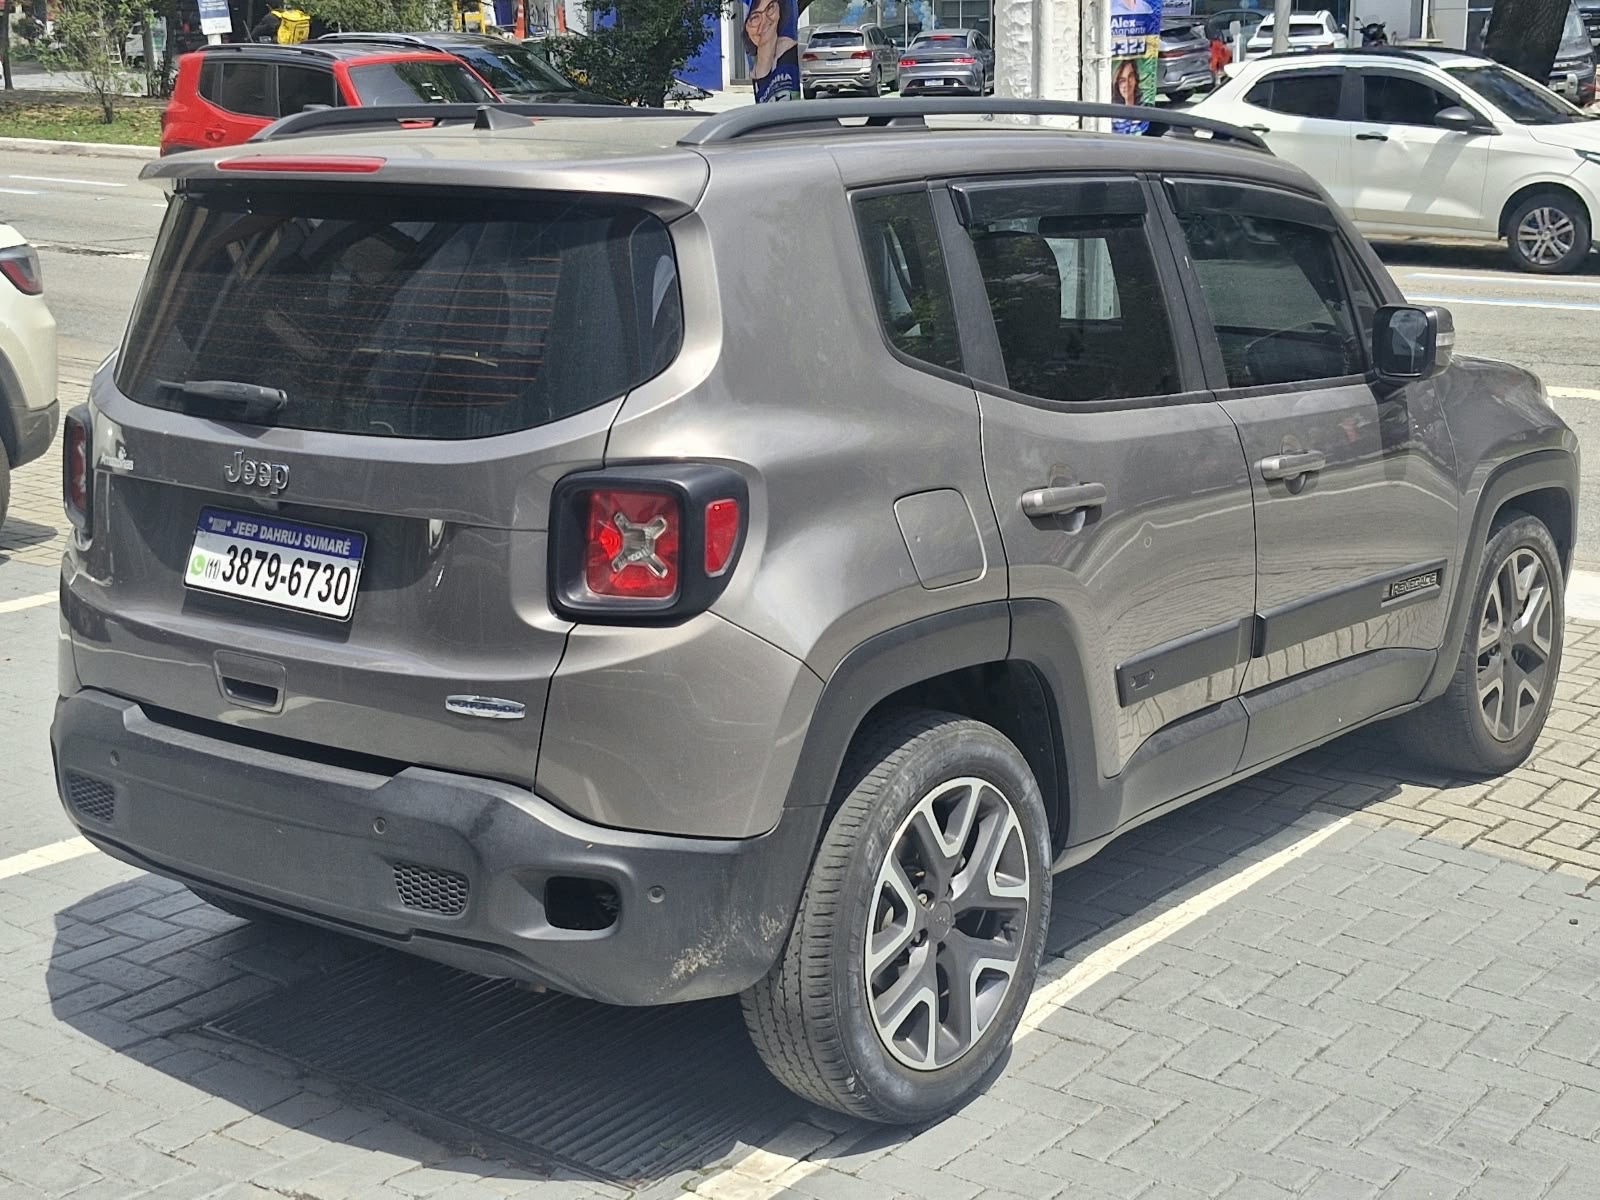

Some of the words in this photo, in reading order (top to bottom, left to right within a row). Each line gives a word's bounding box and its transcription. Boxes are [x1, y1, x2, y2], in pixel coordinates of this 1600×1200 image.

[1111, 16, 1136, 28] Alex
[224, 449, 290, 494] Jeep
[232, 521, 259, 537] JEEP
[259, 526, 302, 546] DAHRUJ
[303, 538, 352, 556] SUMARÉ
[222, 544, 351, 606] 3879-6730
